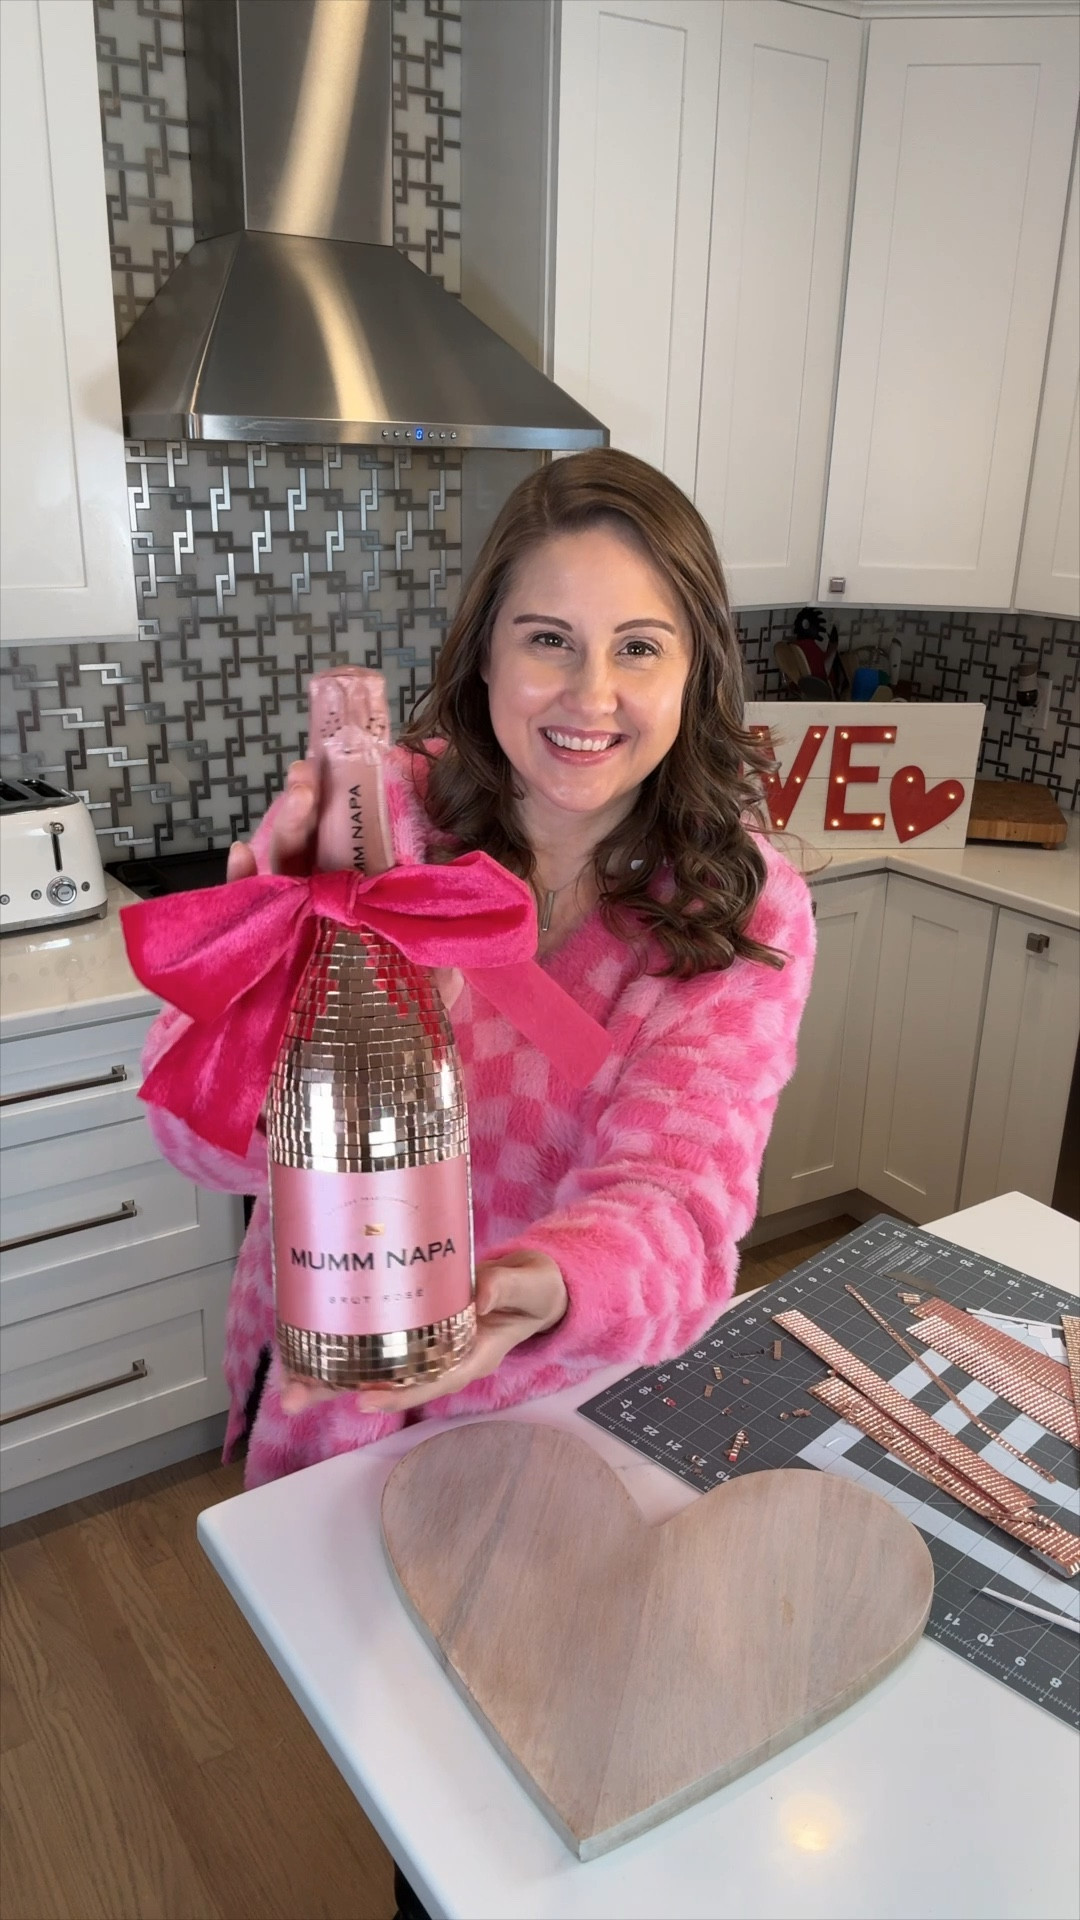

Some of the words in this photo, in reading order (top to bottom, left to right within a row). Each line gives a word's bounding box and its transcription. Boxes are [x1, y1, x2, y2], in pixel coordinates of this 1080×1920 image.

[349, 784, 365, 839] NAPA
[290, 1247, 375, 1271] MUMM
[386, 1238, 457, 1269] NAPA
[959, 1259, 975, 1268] 20
[983, 1269, 997, 1277] 19
[1007, 1279, 1021, 1288] 18
[1031, 1291, 1045, 1299] 17
[328, 1296, 371, 1305] BRUT
[1055, 1301, 1070, 1310] 16
[744, 1317, 757, 1325] 10
[727, 1328, 740, 1337] 11
[710, 1339, 724, 1348] 12
[693, 1350, 707, 1359] 13
[675, 1361, 689, 1371] 14
[657, 1373, 671, 1383] 15
[638, 1386, 653, 1396] 16
[620, 1399, 633, 1409] 17
[620, 1411, 637, 1422] 23
[642, 1424, 660, 1437] 22
[665, 1439, 683, 1451] 21
[944, 1612, 961, 1626] 11
[976, 1632, 995, 1647] 10
[1014, 1656, 1027, 1667] 9
[1049, 1677, 1063, 1688] 8
